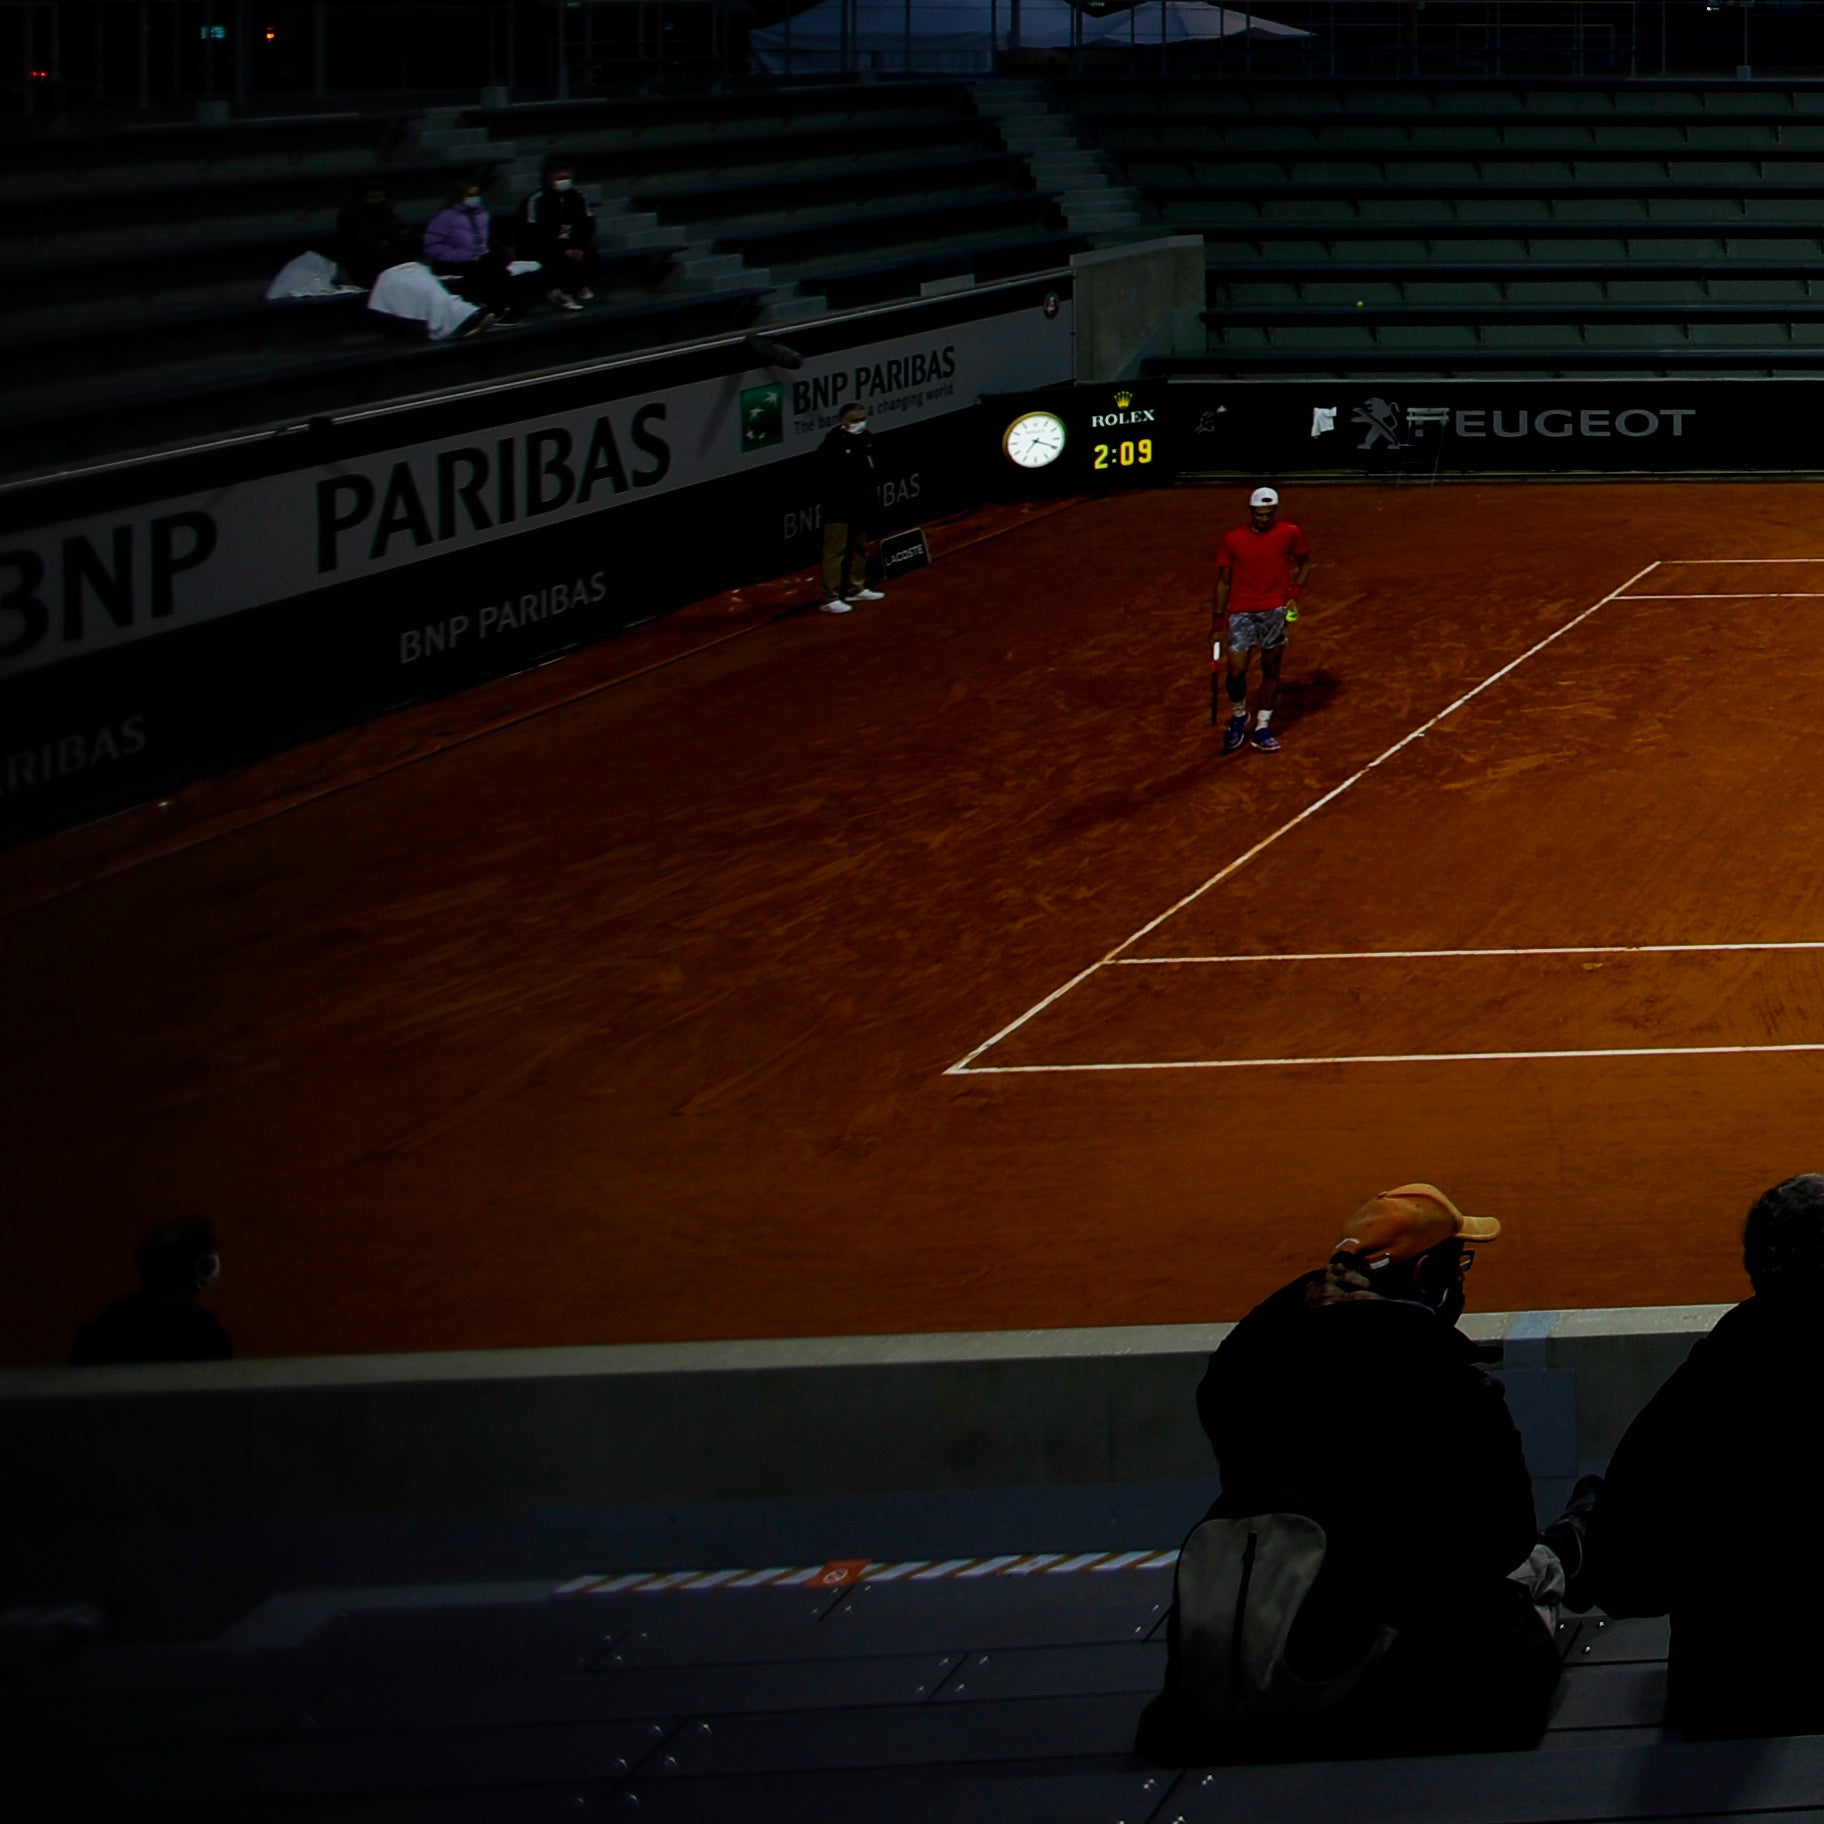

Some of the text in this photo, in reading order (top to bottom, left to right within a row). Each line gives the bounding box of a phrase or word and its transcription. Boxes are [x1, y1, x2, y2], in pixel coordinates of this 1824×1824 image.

[793, 346, 955, 415] BNP PARIBAS
[1091, 408, 1156, 428] ROLEX
[1414, 408, 1697, 438] EUGEOT
[1093, 438, 1153, 470] 2:09
[318, 403, 670, 574] PARIBAS
[885, 543, 925, 567] LACOSTE
[401, 570, 609, 665] BNP PARIBAS
[0, 714, 148, 798] RIBAS
